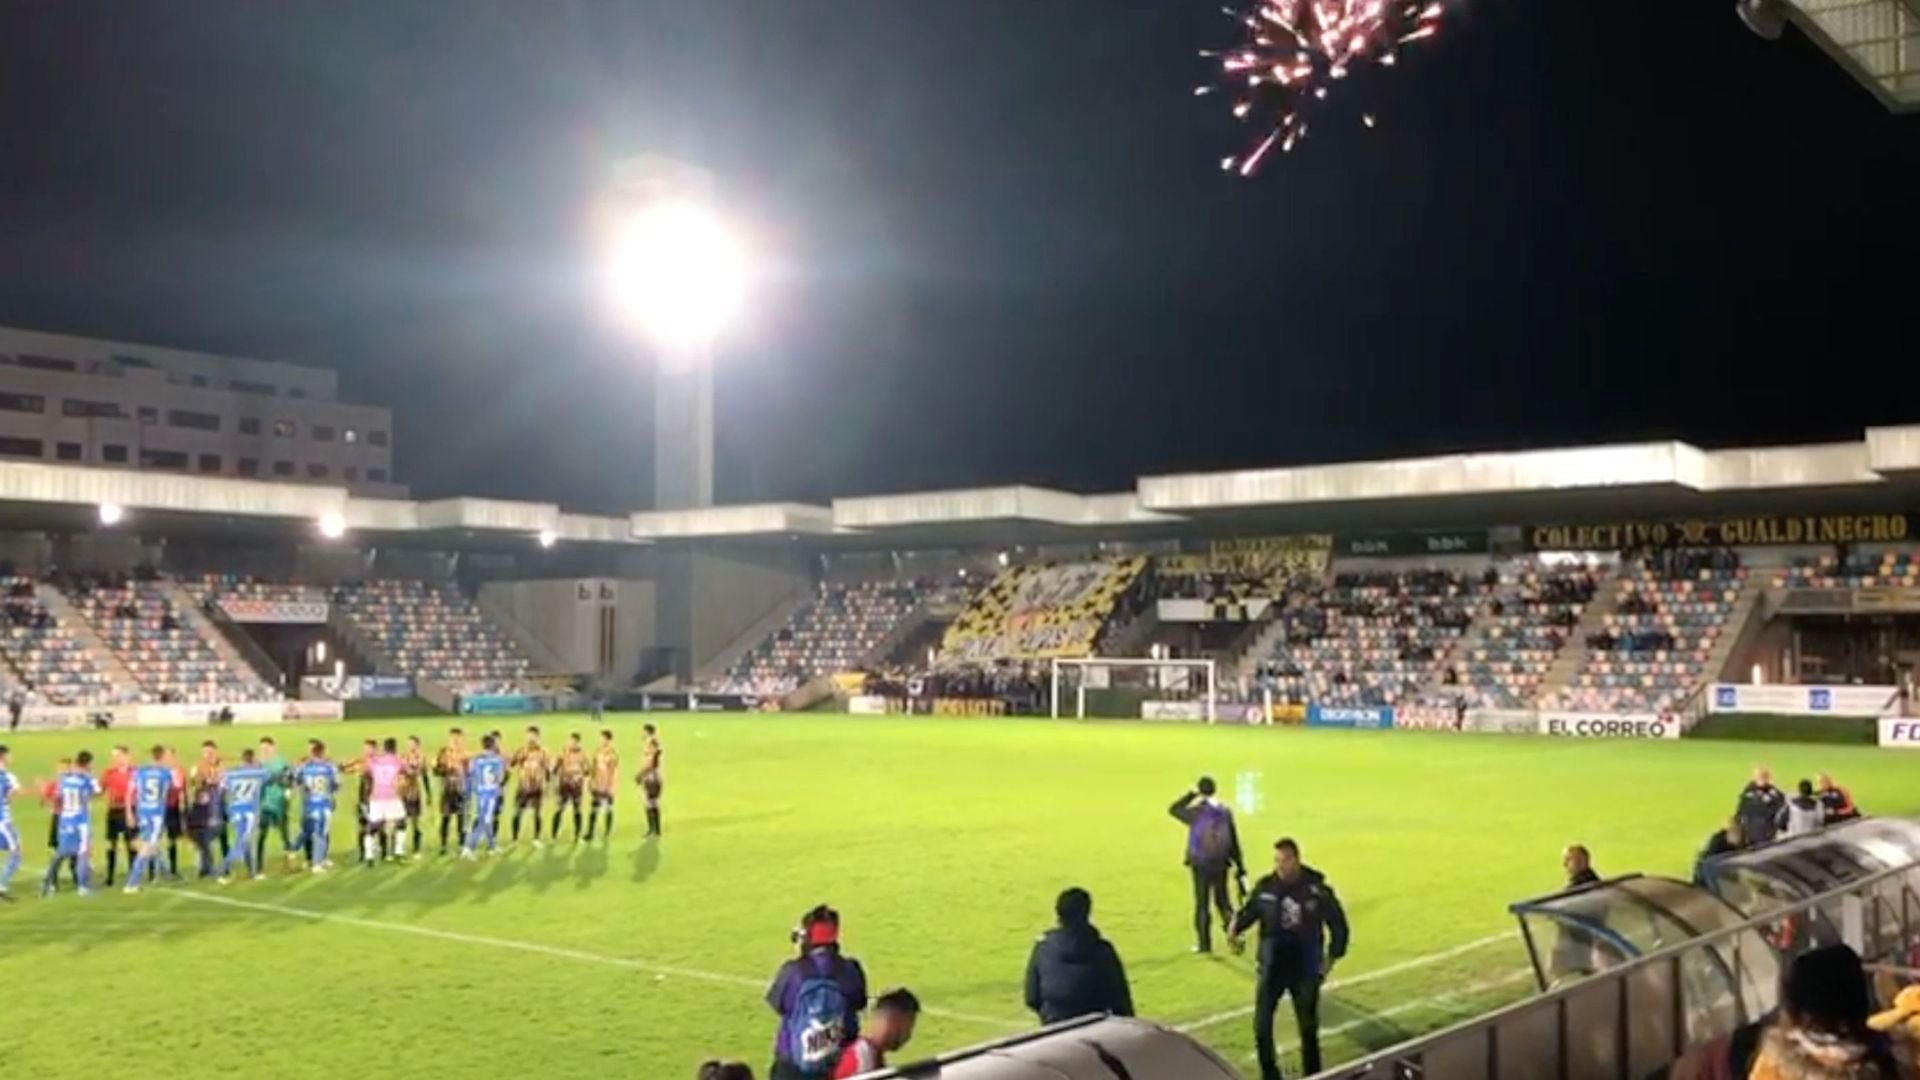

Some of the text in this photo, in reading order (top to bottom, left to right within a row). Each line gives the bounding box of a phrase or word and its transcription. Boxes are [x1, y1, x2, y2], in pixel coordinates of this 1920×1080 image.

[1533, 515, 1909, 548] COLECTIVO GUALDINEGRO
[1549, 719, 1665, 737] EL CORREO
[144, 777, 161, 808] 5
